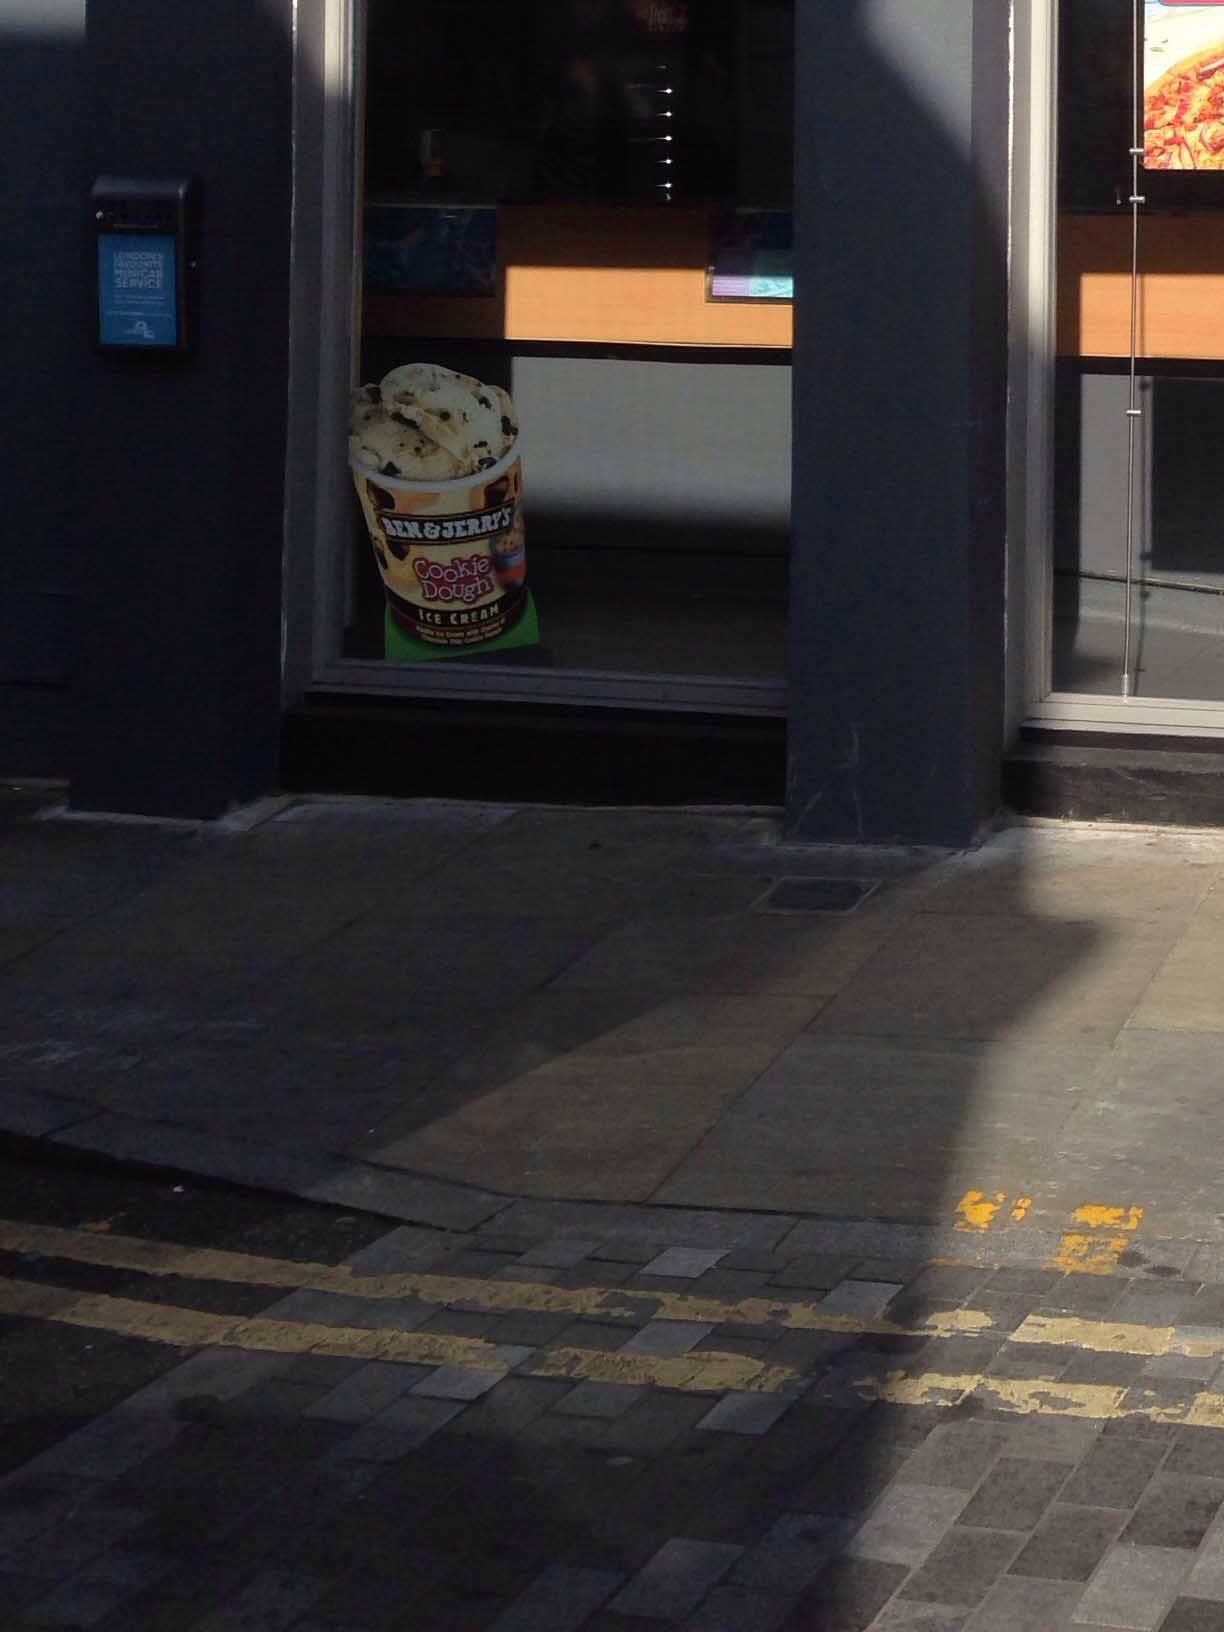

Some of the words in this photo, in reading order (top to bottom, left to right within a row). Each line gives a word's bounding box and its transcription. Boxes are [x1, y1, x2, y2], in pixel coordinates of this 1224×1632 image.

[414, 556, 490, 583] Cookie
[422, 578, 492, 602] Dough
[418, 608, 442, 625] ICE
[449, 604, 499, 625] CREAM
